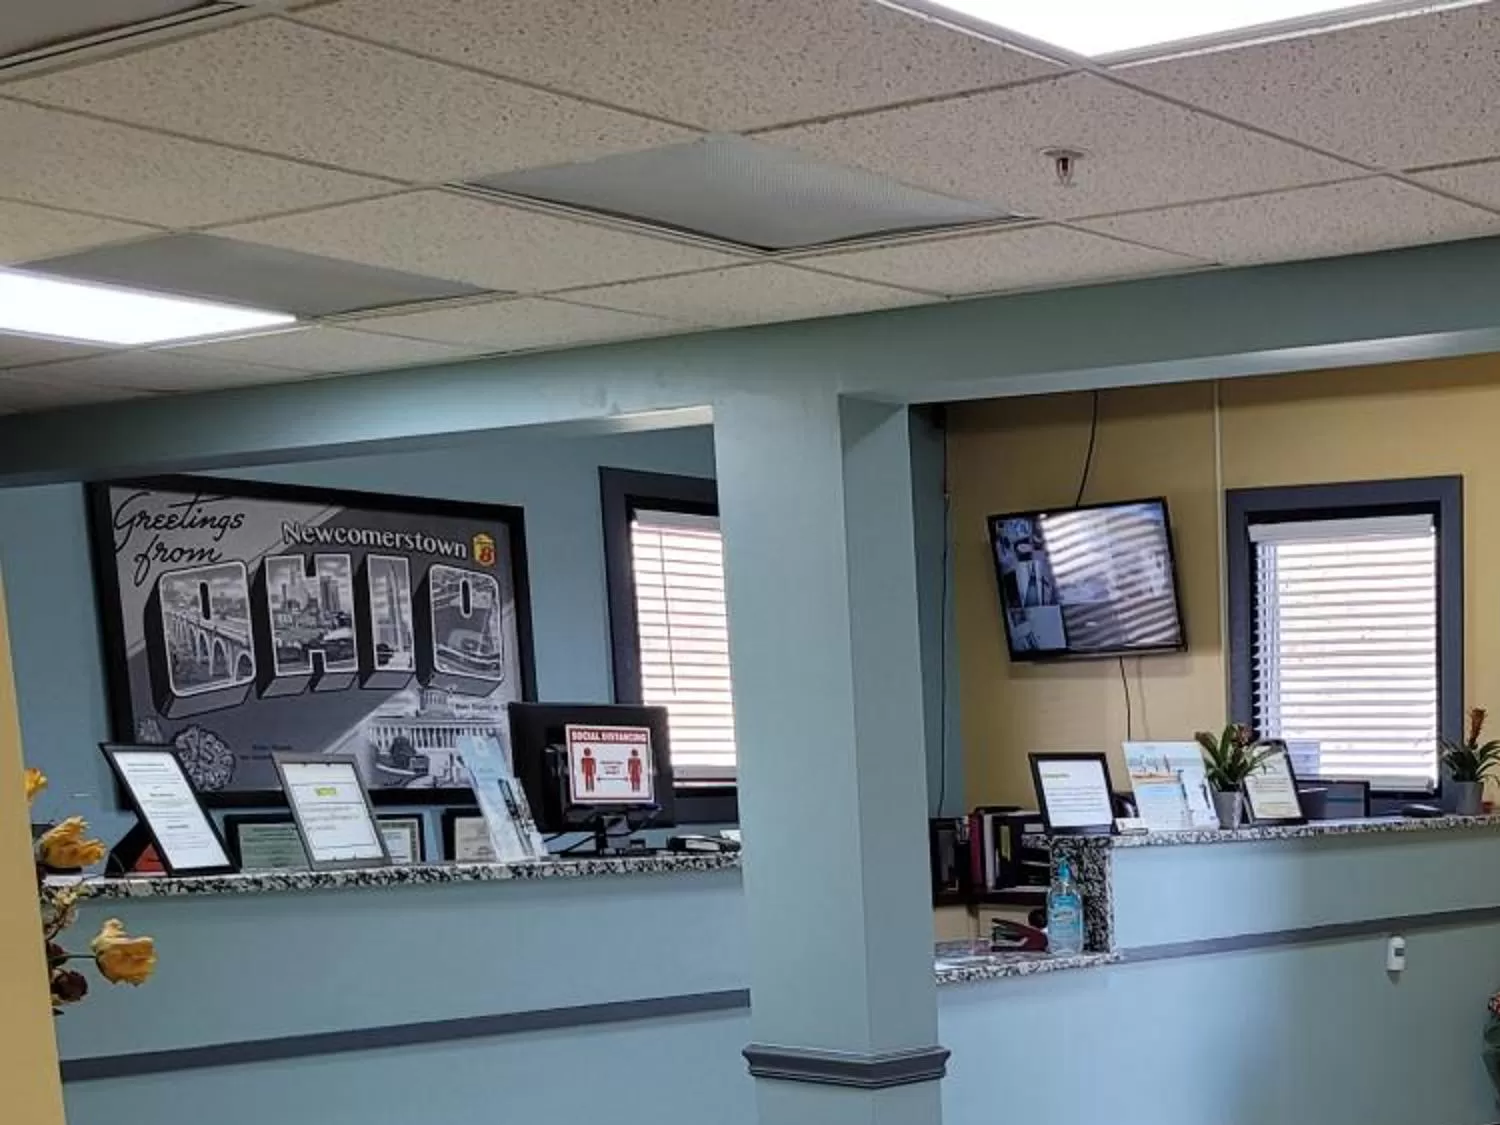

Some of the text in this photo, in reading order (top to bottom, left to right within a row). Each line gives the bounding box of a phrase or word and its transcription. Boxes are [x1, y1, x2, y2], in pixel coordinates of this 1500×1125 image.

[114, 492, 245, 553] Greetings
[281, 521, 468, 559] Newcomerstown
[134, 534, 223, 587] from
[150, 553, 505, 705] OHIO
[571, 730, 602, 741] SOCIAL
